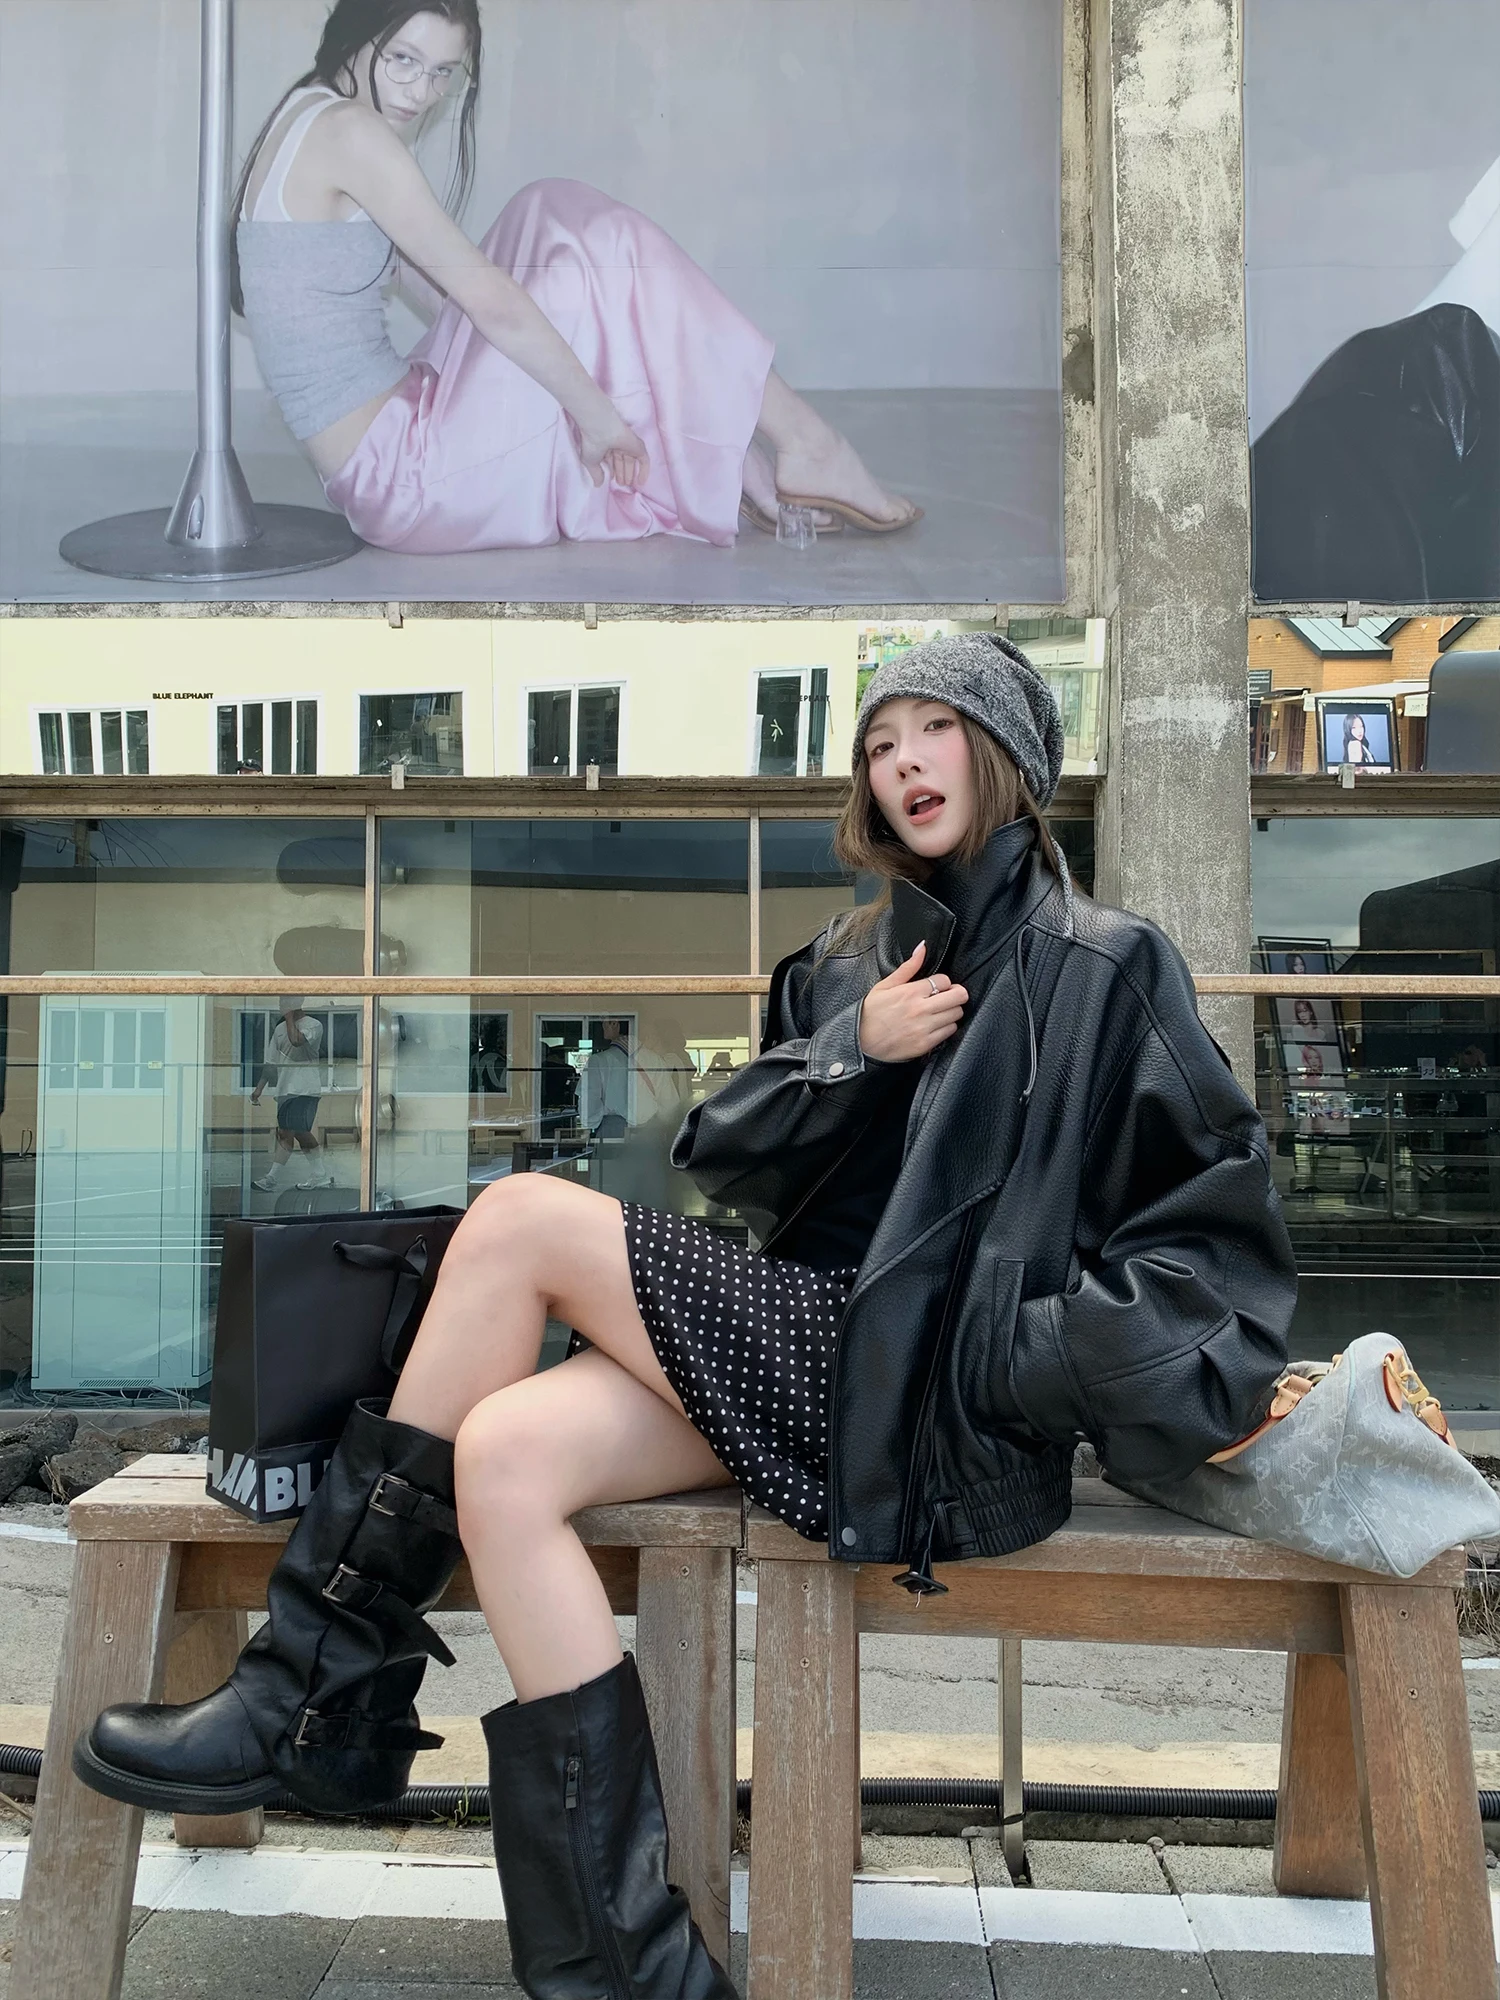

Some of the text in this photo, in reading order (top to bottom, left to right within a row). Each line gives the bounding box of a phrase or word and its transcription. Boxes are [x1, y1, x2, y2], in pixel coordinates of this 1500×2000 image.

[152, 692, 214, 700] BLUE ELEPHANT
[264, 1459, 331, 1514] BL
